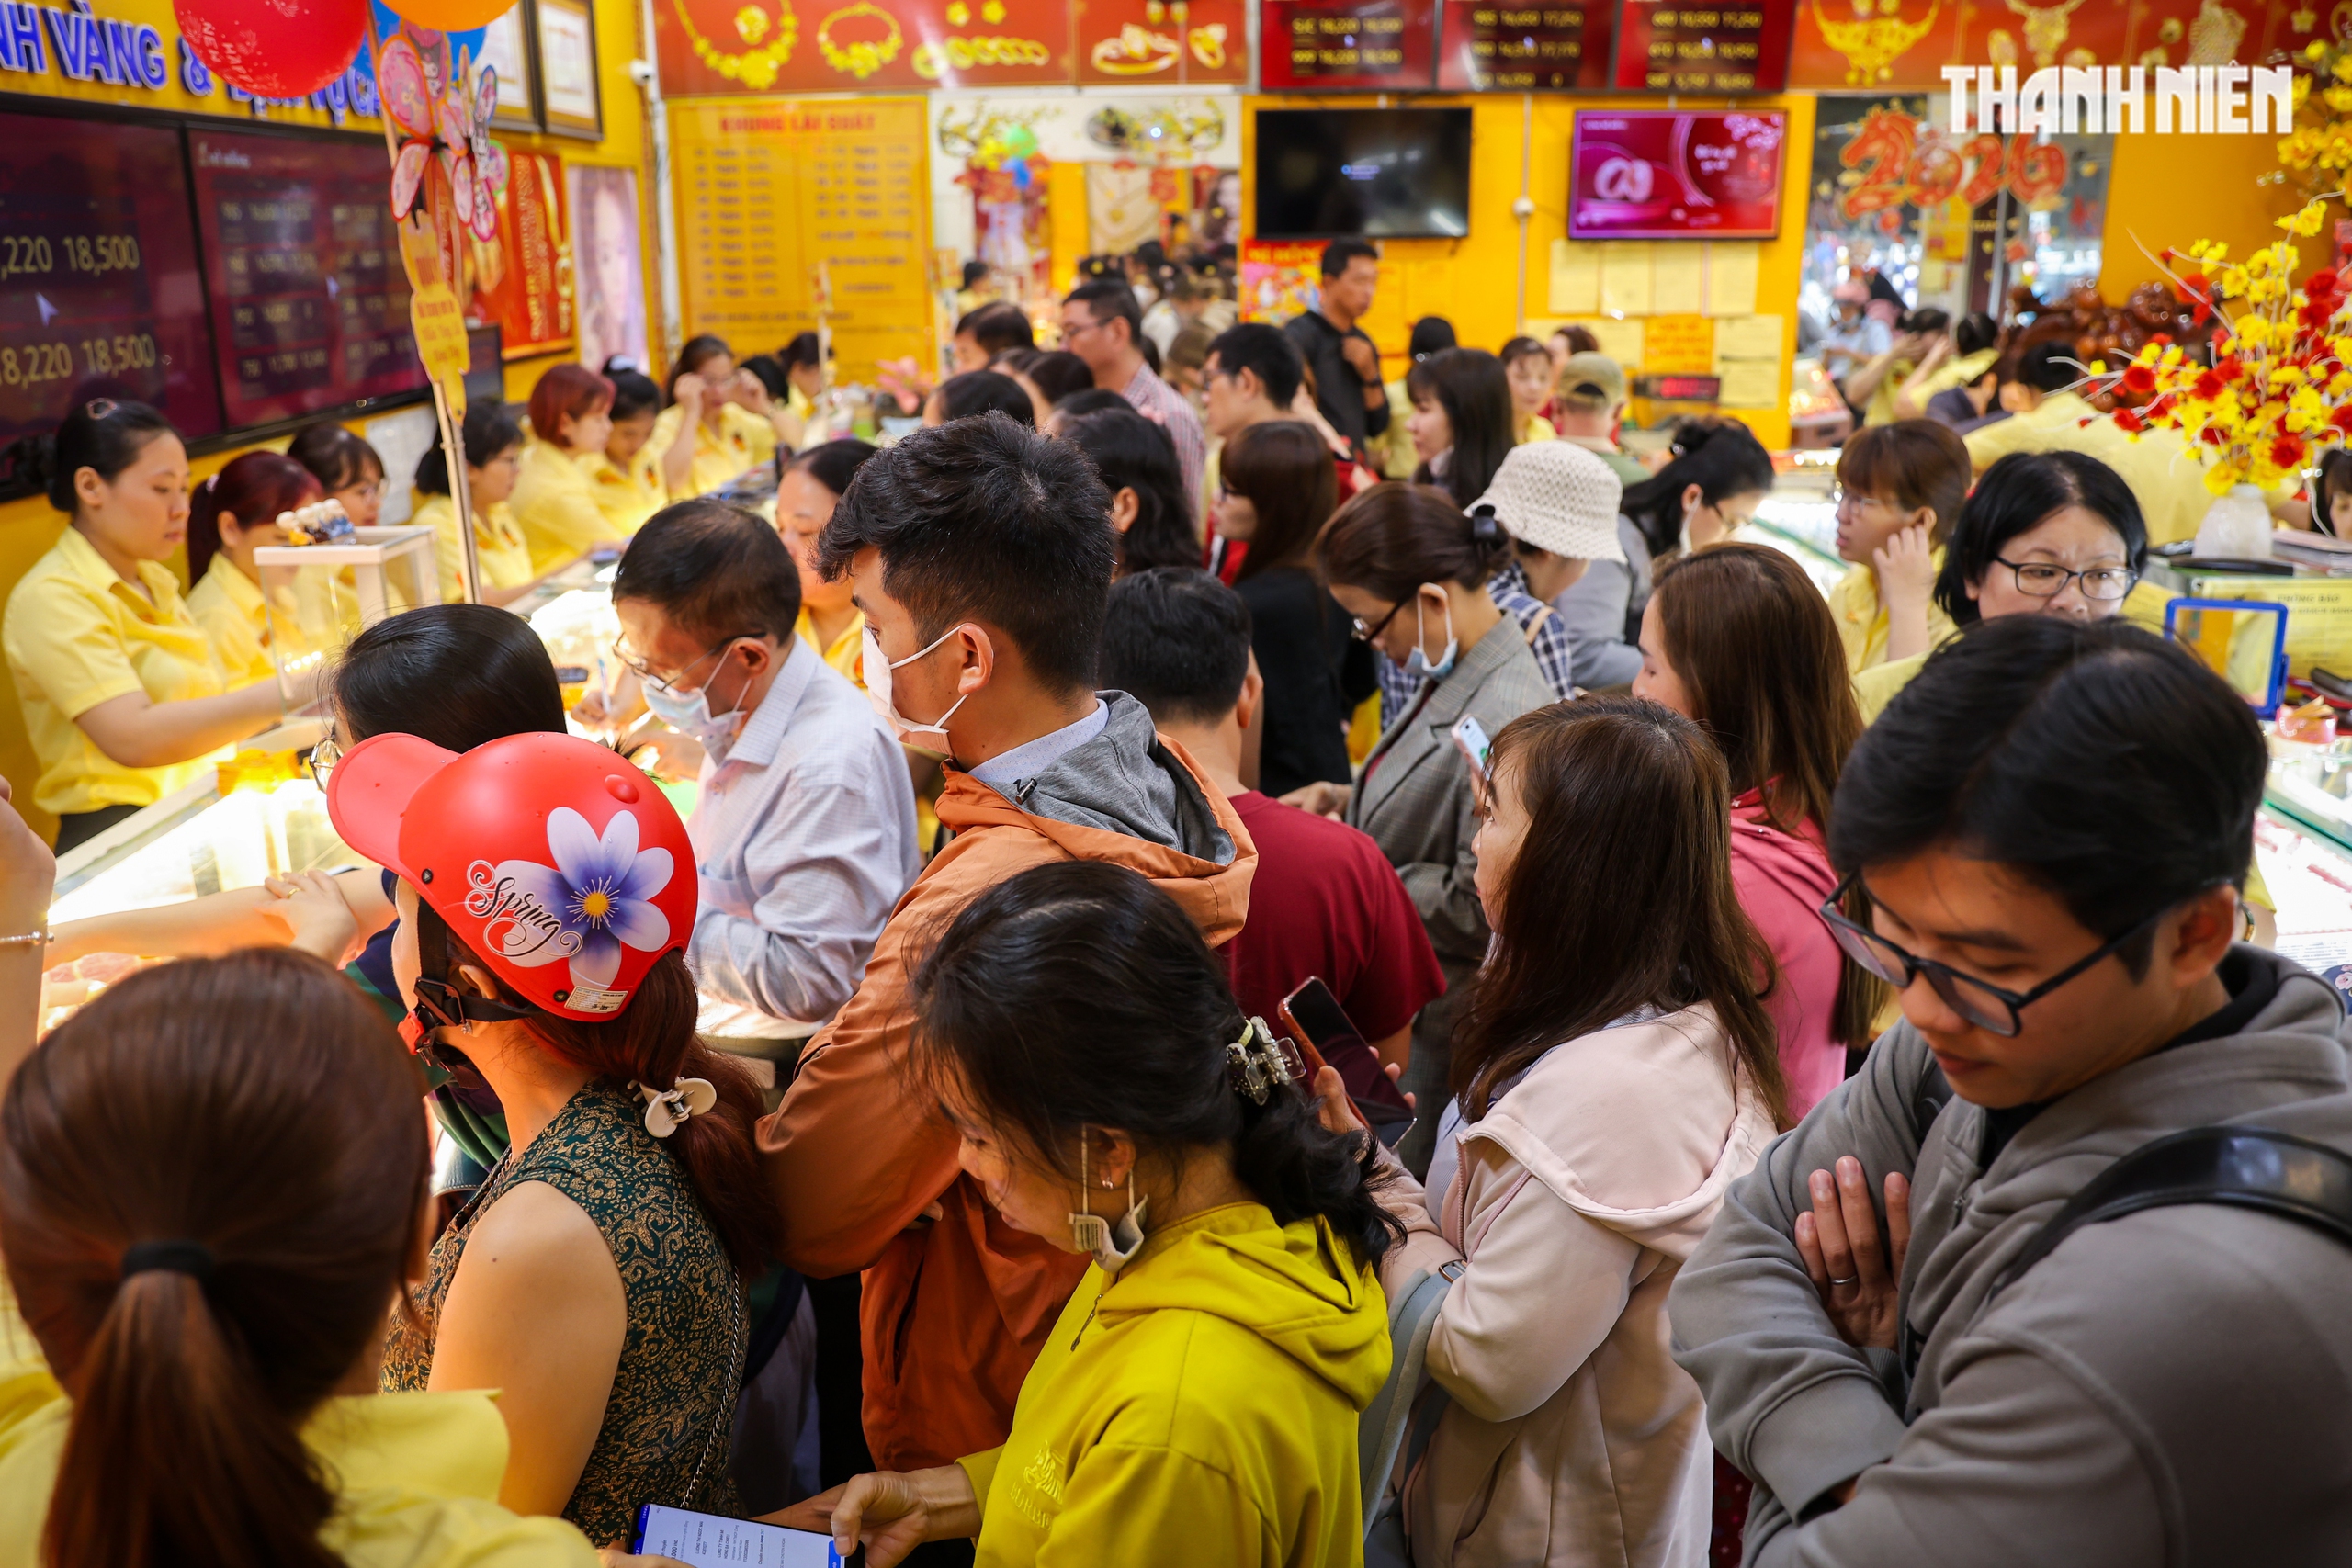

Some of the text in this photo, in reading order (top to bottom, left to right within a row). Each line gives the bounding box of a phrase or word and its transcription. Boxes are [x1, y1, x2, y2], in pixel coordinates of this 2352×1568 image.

[62, 235, 140, 277] 18,500
[80, 333, 156, 378] 18,500
[466, 860, 582, 957] Spring
